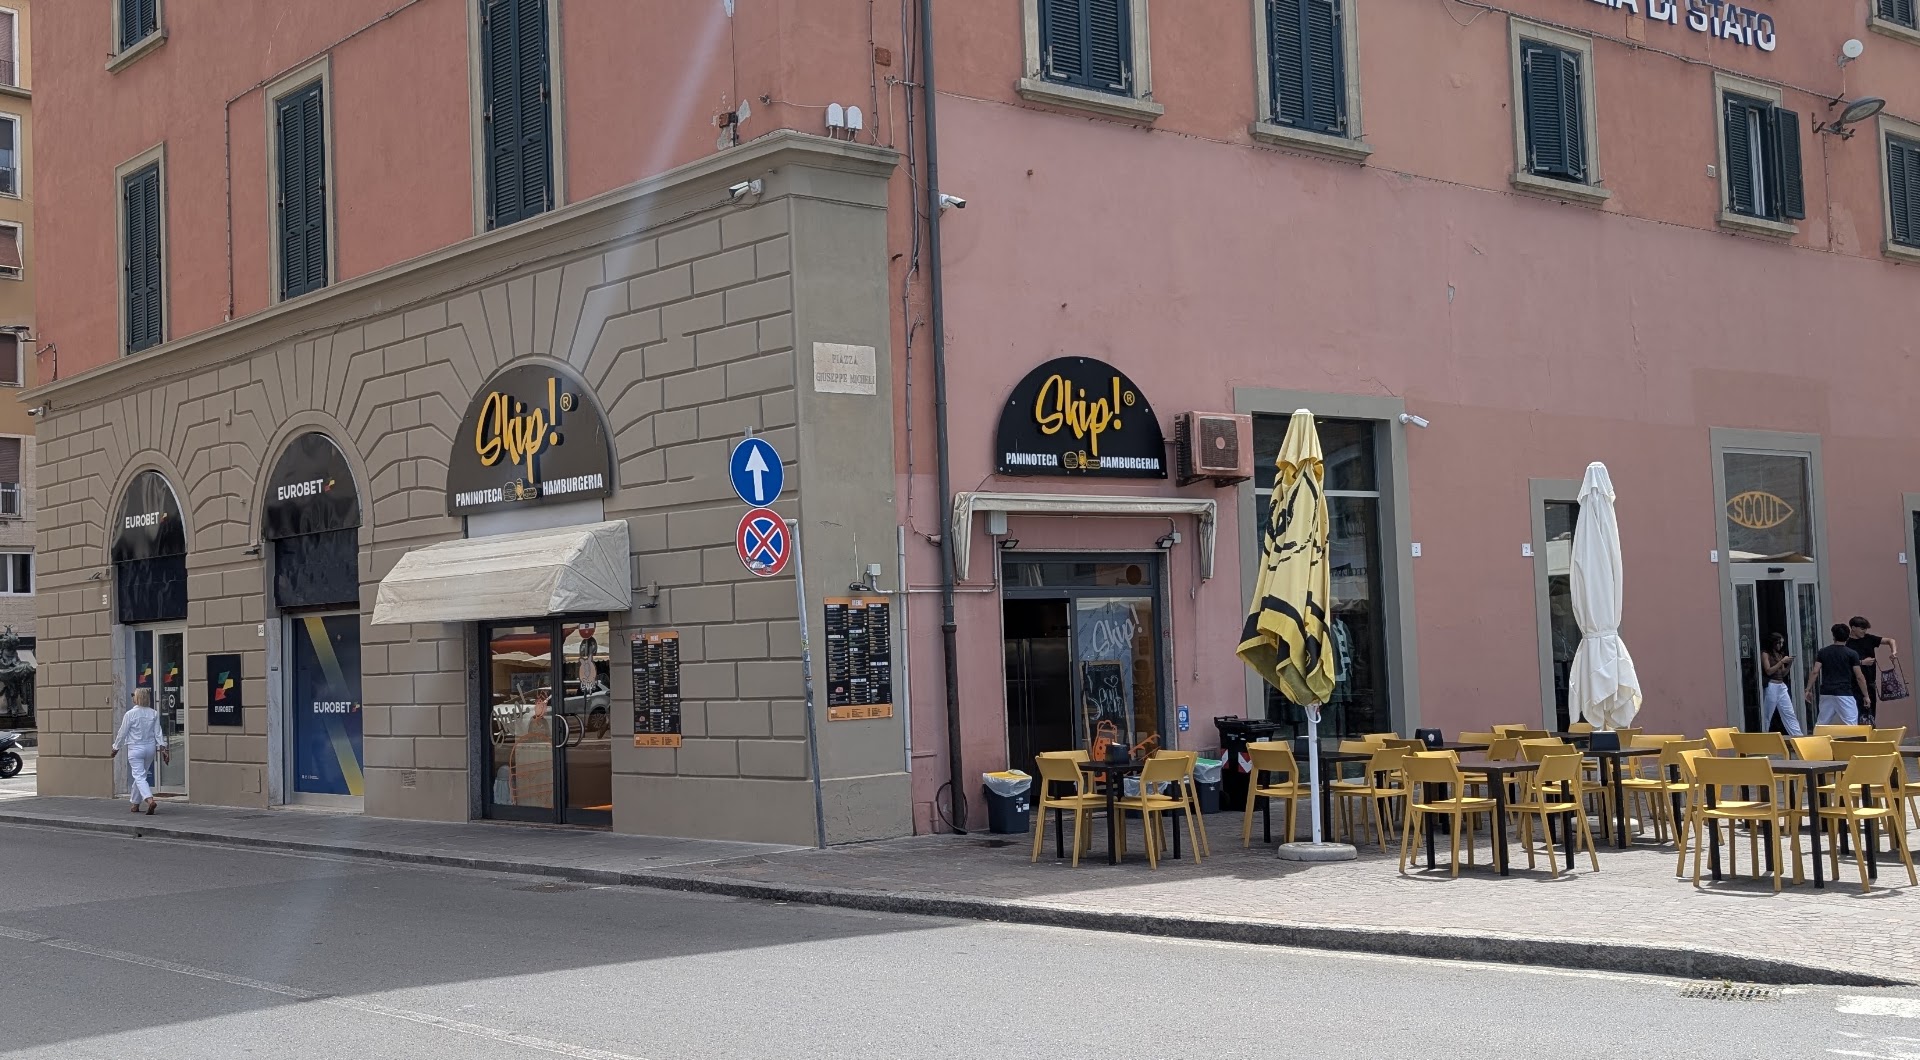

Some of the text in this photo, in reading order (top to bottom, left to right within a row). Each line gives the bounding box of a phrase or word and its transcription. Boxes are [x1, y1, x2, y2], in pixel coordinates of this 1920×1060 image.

[1685, 0, 1776, 51] STATO
[832, 354, 858, 365] PIAZZA
[816, 372, 848, 383] GIUSEPPE
[1006, 452, 1160, 470] PANINOTECA HAMBURGERIA
[277, 478, 324, 501] EUROBET
[455, 473, 603, 507] PANINOTECA HAMBURGERIA
[1733, 493, 1781, 527] SCOUT
[125, 511, 160, 529] EUROBET
[313, 702, 352, 714] EUROBET
